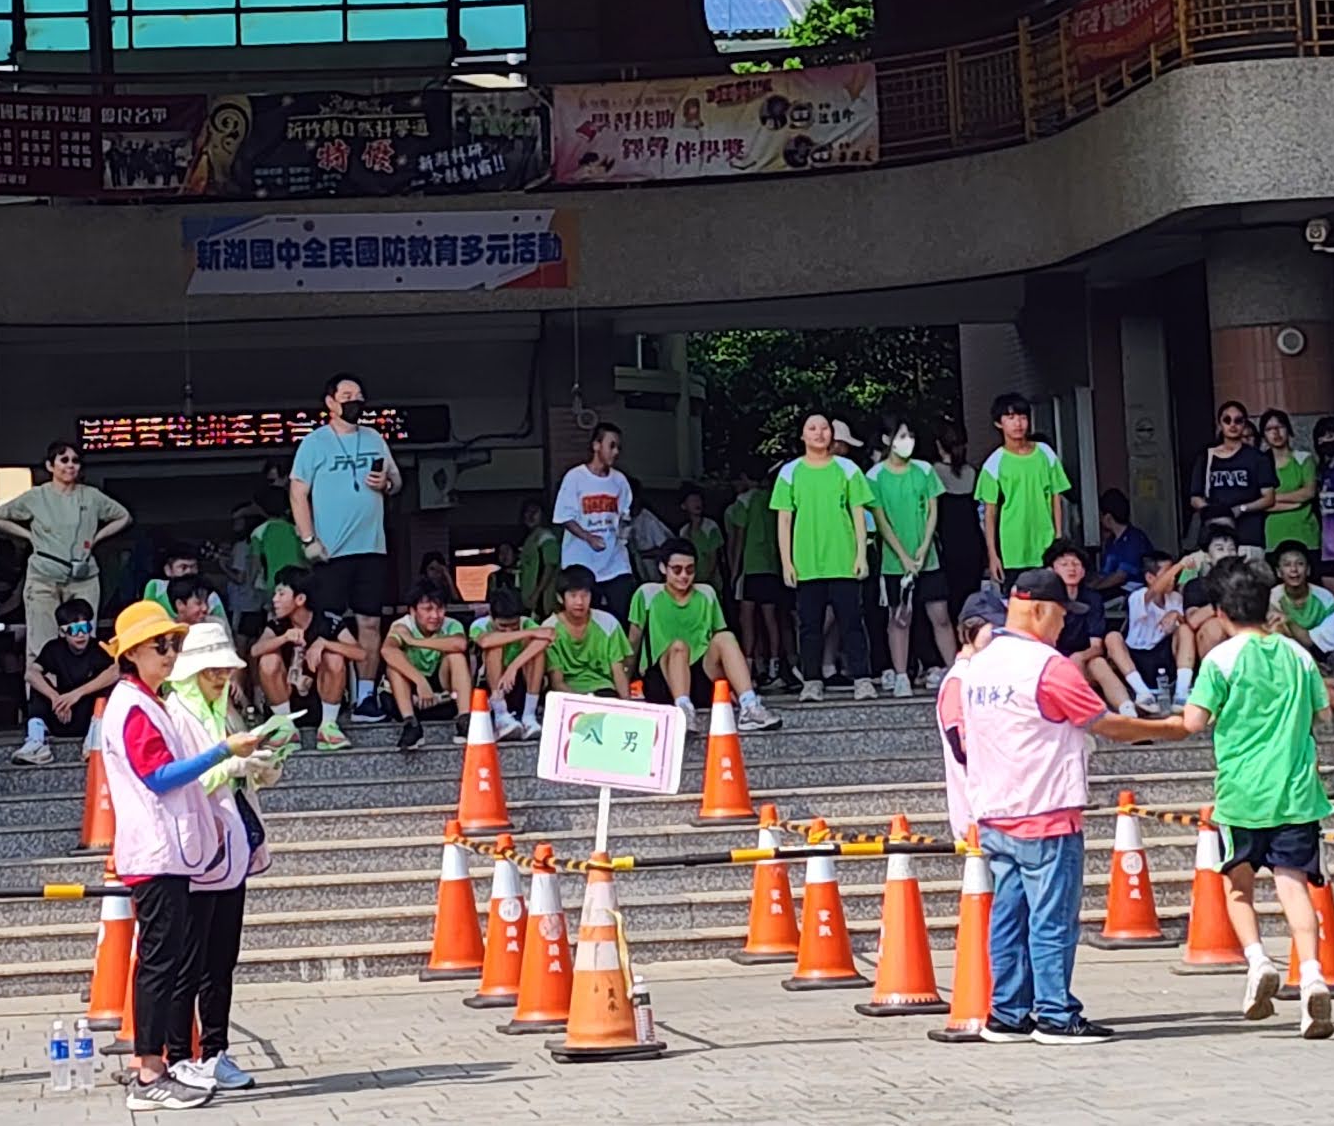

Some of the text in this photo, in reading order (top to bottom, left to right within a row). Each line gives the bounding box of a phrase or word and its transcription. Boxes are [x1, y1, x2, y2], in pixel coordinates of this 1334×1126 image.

[196, 232, 562, 271] 新湖國中全民國防教育多元活動
[581, 727, 639, 753] 八男
